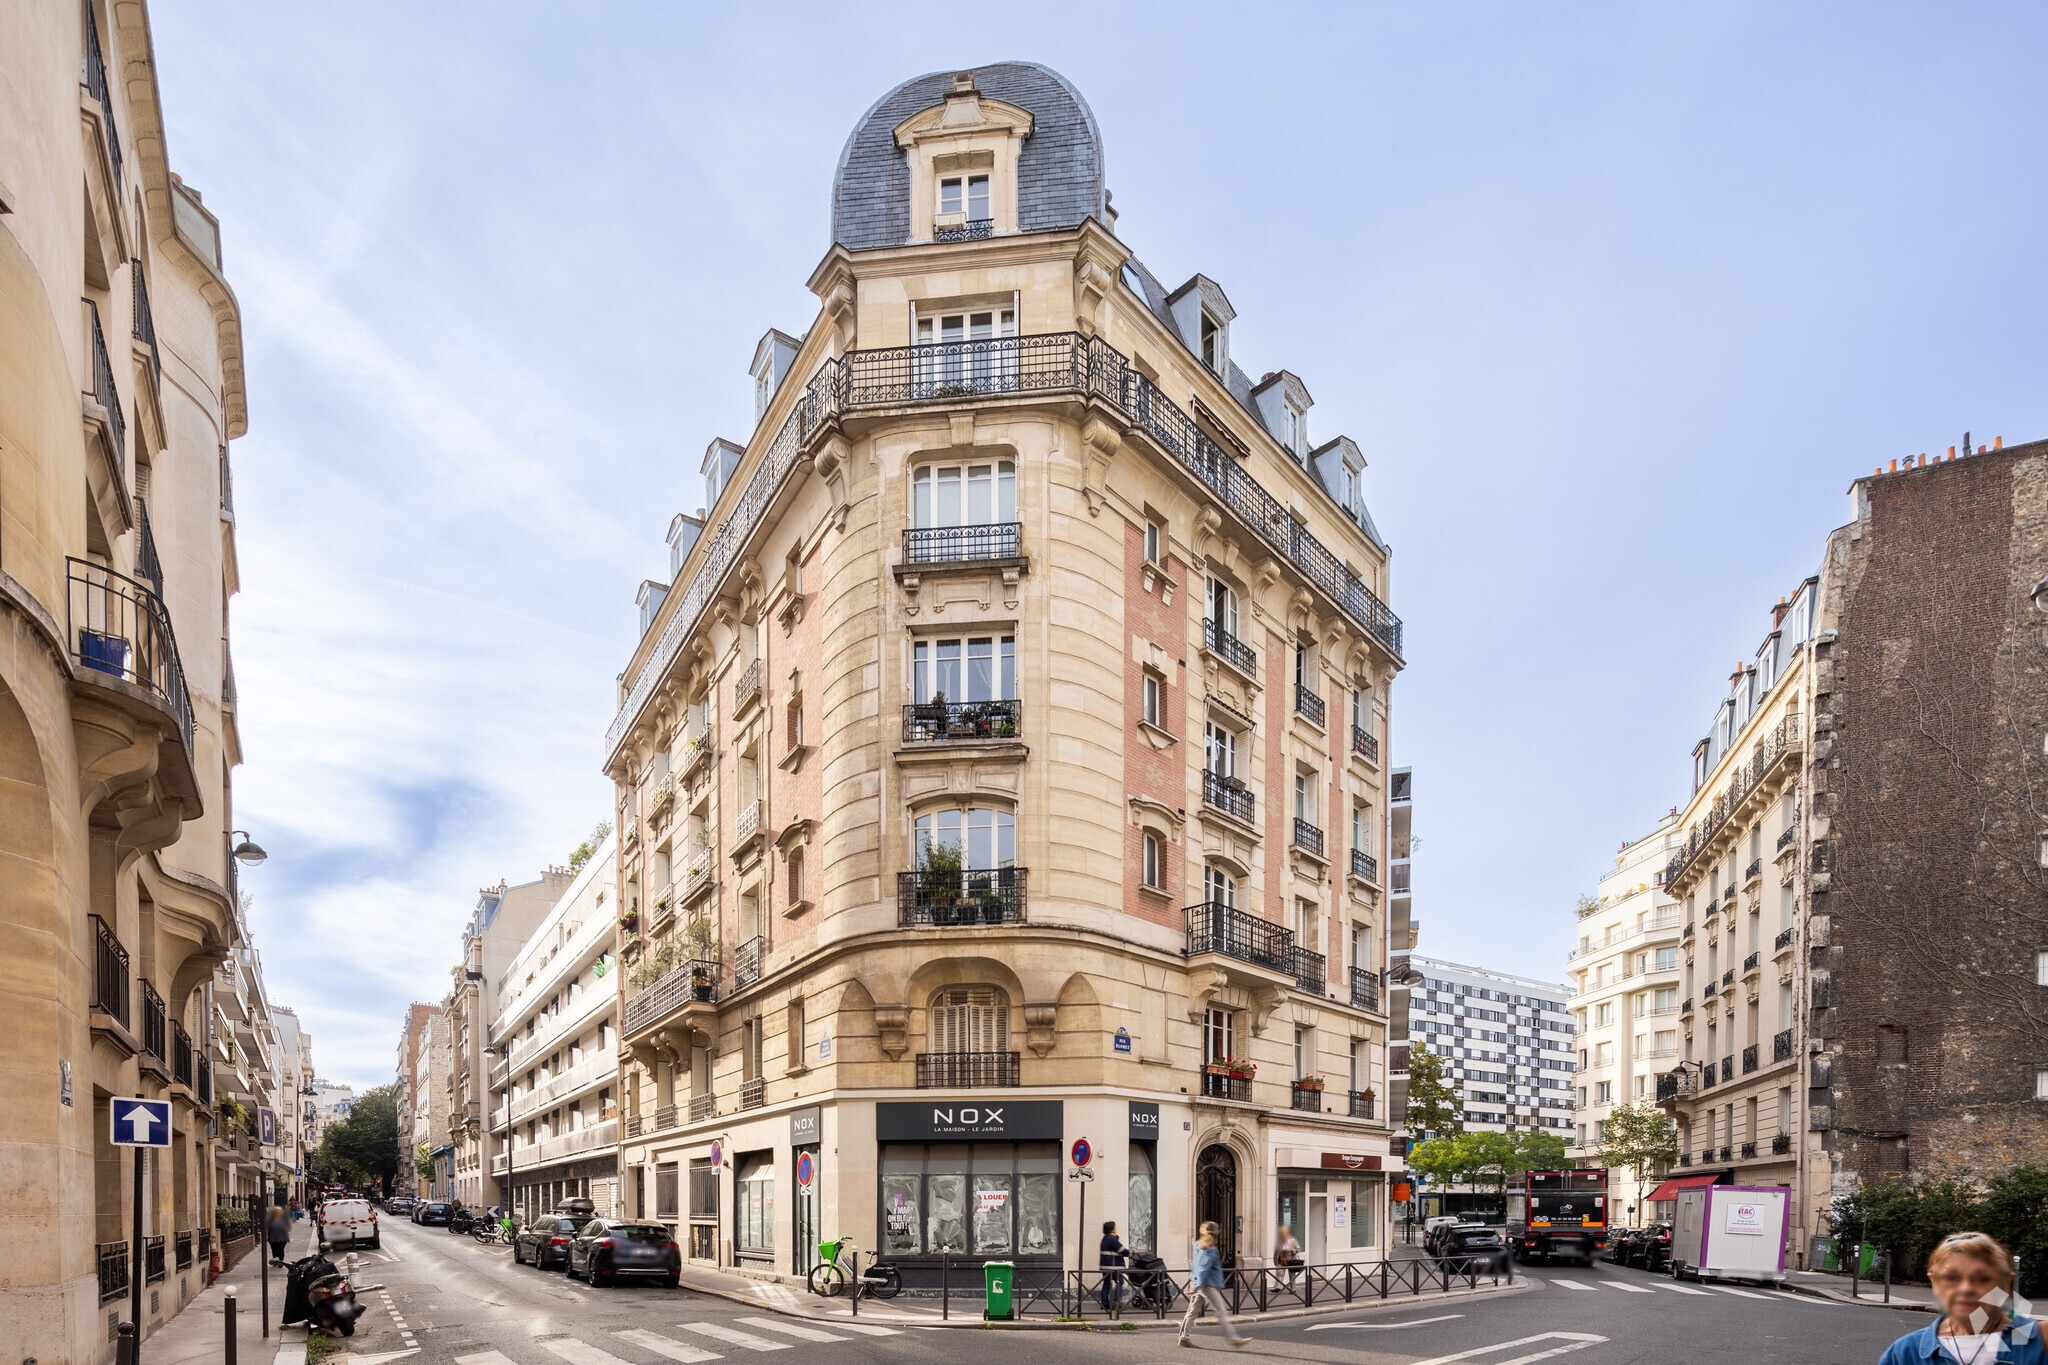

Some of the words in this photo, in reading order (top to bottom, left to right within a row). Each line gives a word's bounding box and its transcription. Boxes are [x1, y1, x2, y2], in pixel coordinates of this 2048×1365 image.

[933, 1108, 1004, 1124] NOX
[1132, 1113, 1157, 1124] NOX
[263, 1115, 271, 1137] P
[794, 1117, 815, 1130] NOX
